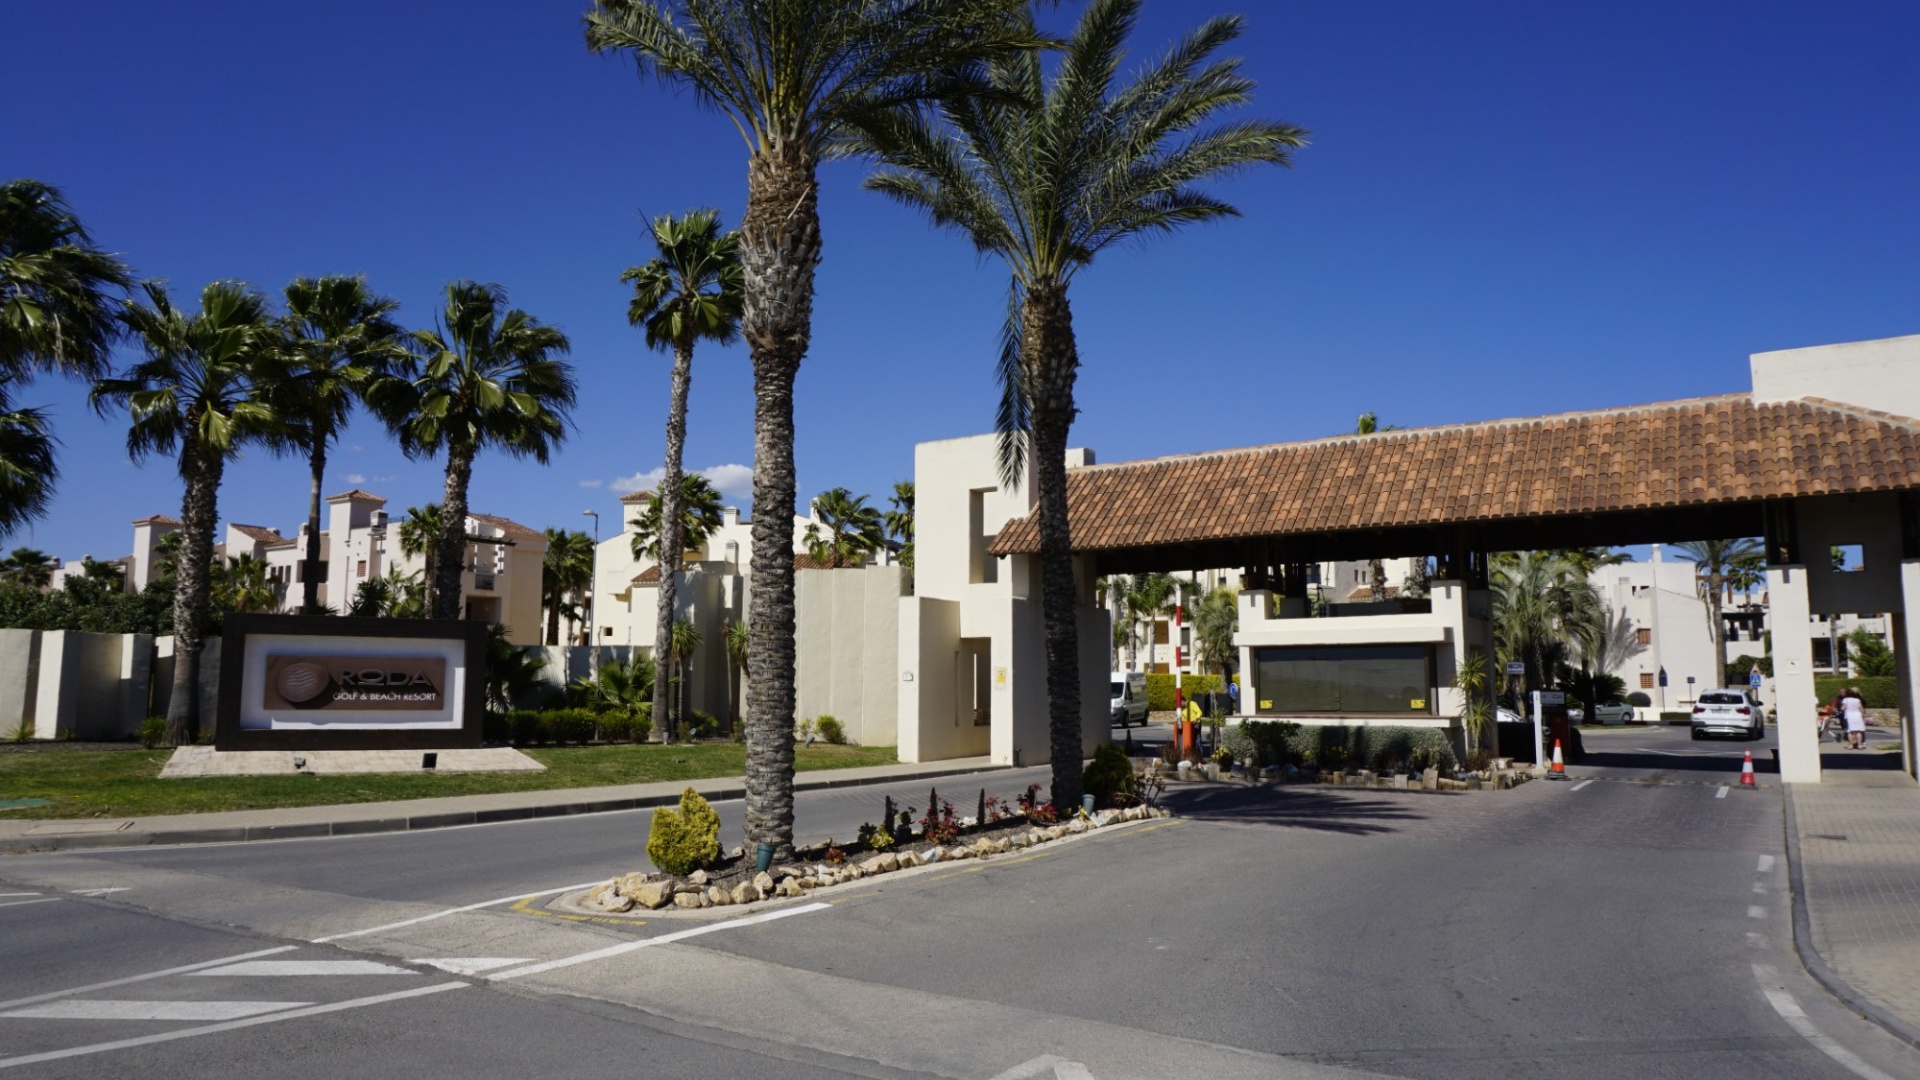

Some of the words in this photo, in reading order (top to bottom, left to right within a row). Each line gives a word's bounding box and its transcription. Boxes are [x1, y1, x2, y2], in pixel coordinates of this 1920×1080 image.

[339, 668, 432, 686] RODA
[333, 692, 358, 701] GOLF
[360, 693, 367, 701] &
[370, 692, 400, 701] BEACH
[403, 693, 436, 701] RESORT
